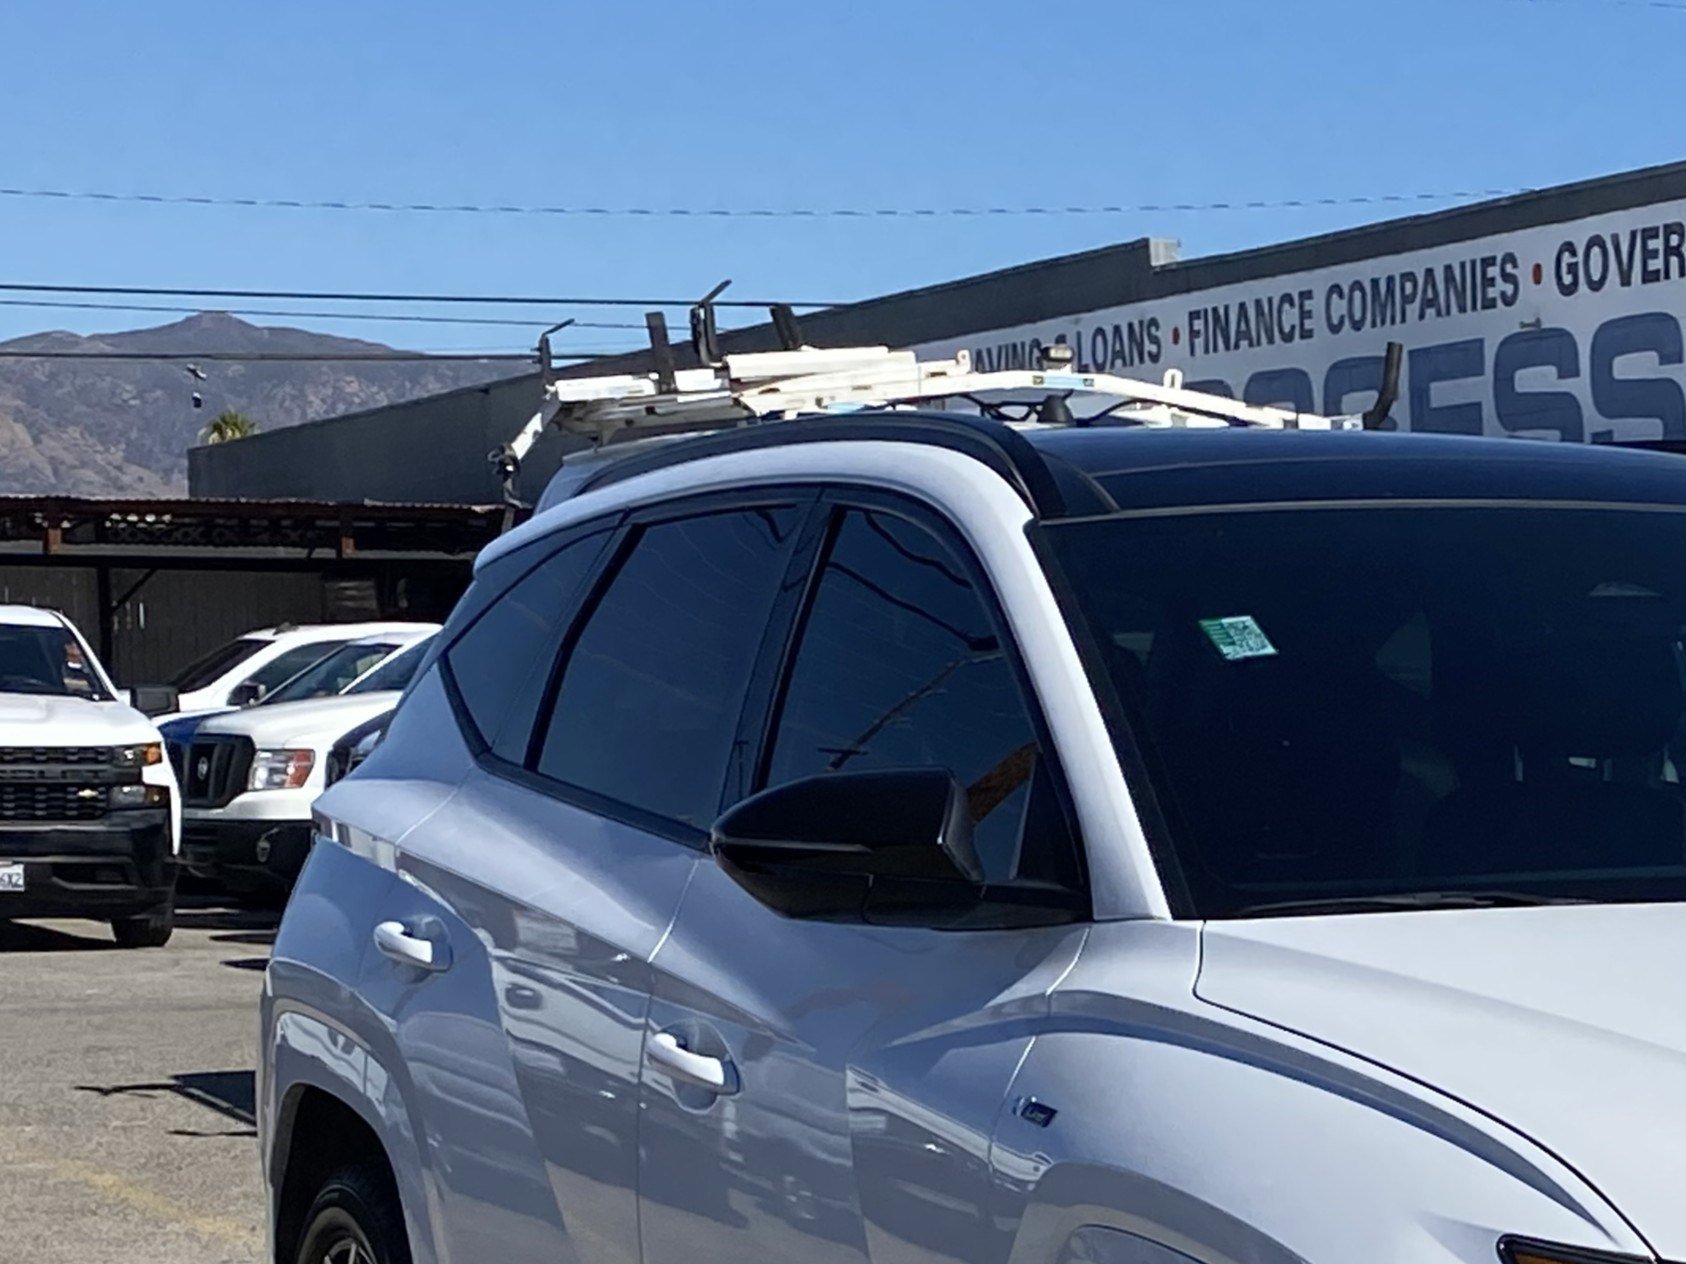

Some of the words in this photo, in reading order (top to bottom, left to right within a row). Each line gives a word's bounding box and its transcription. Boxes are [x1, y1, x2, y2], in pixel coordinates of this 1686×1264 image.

[974, 337, 1044, 374] AVING
[1075, 316, 1162, 374] LOANS
[1187, 289, 1314, 357] FINANCE
[1324, 251, 1519, 335] COMPANIES
